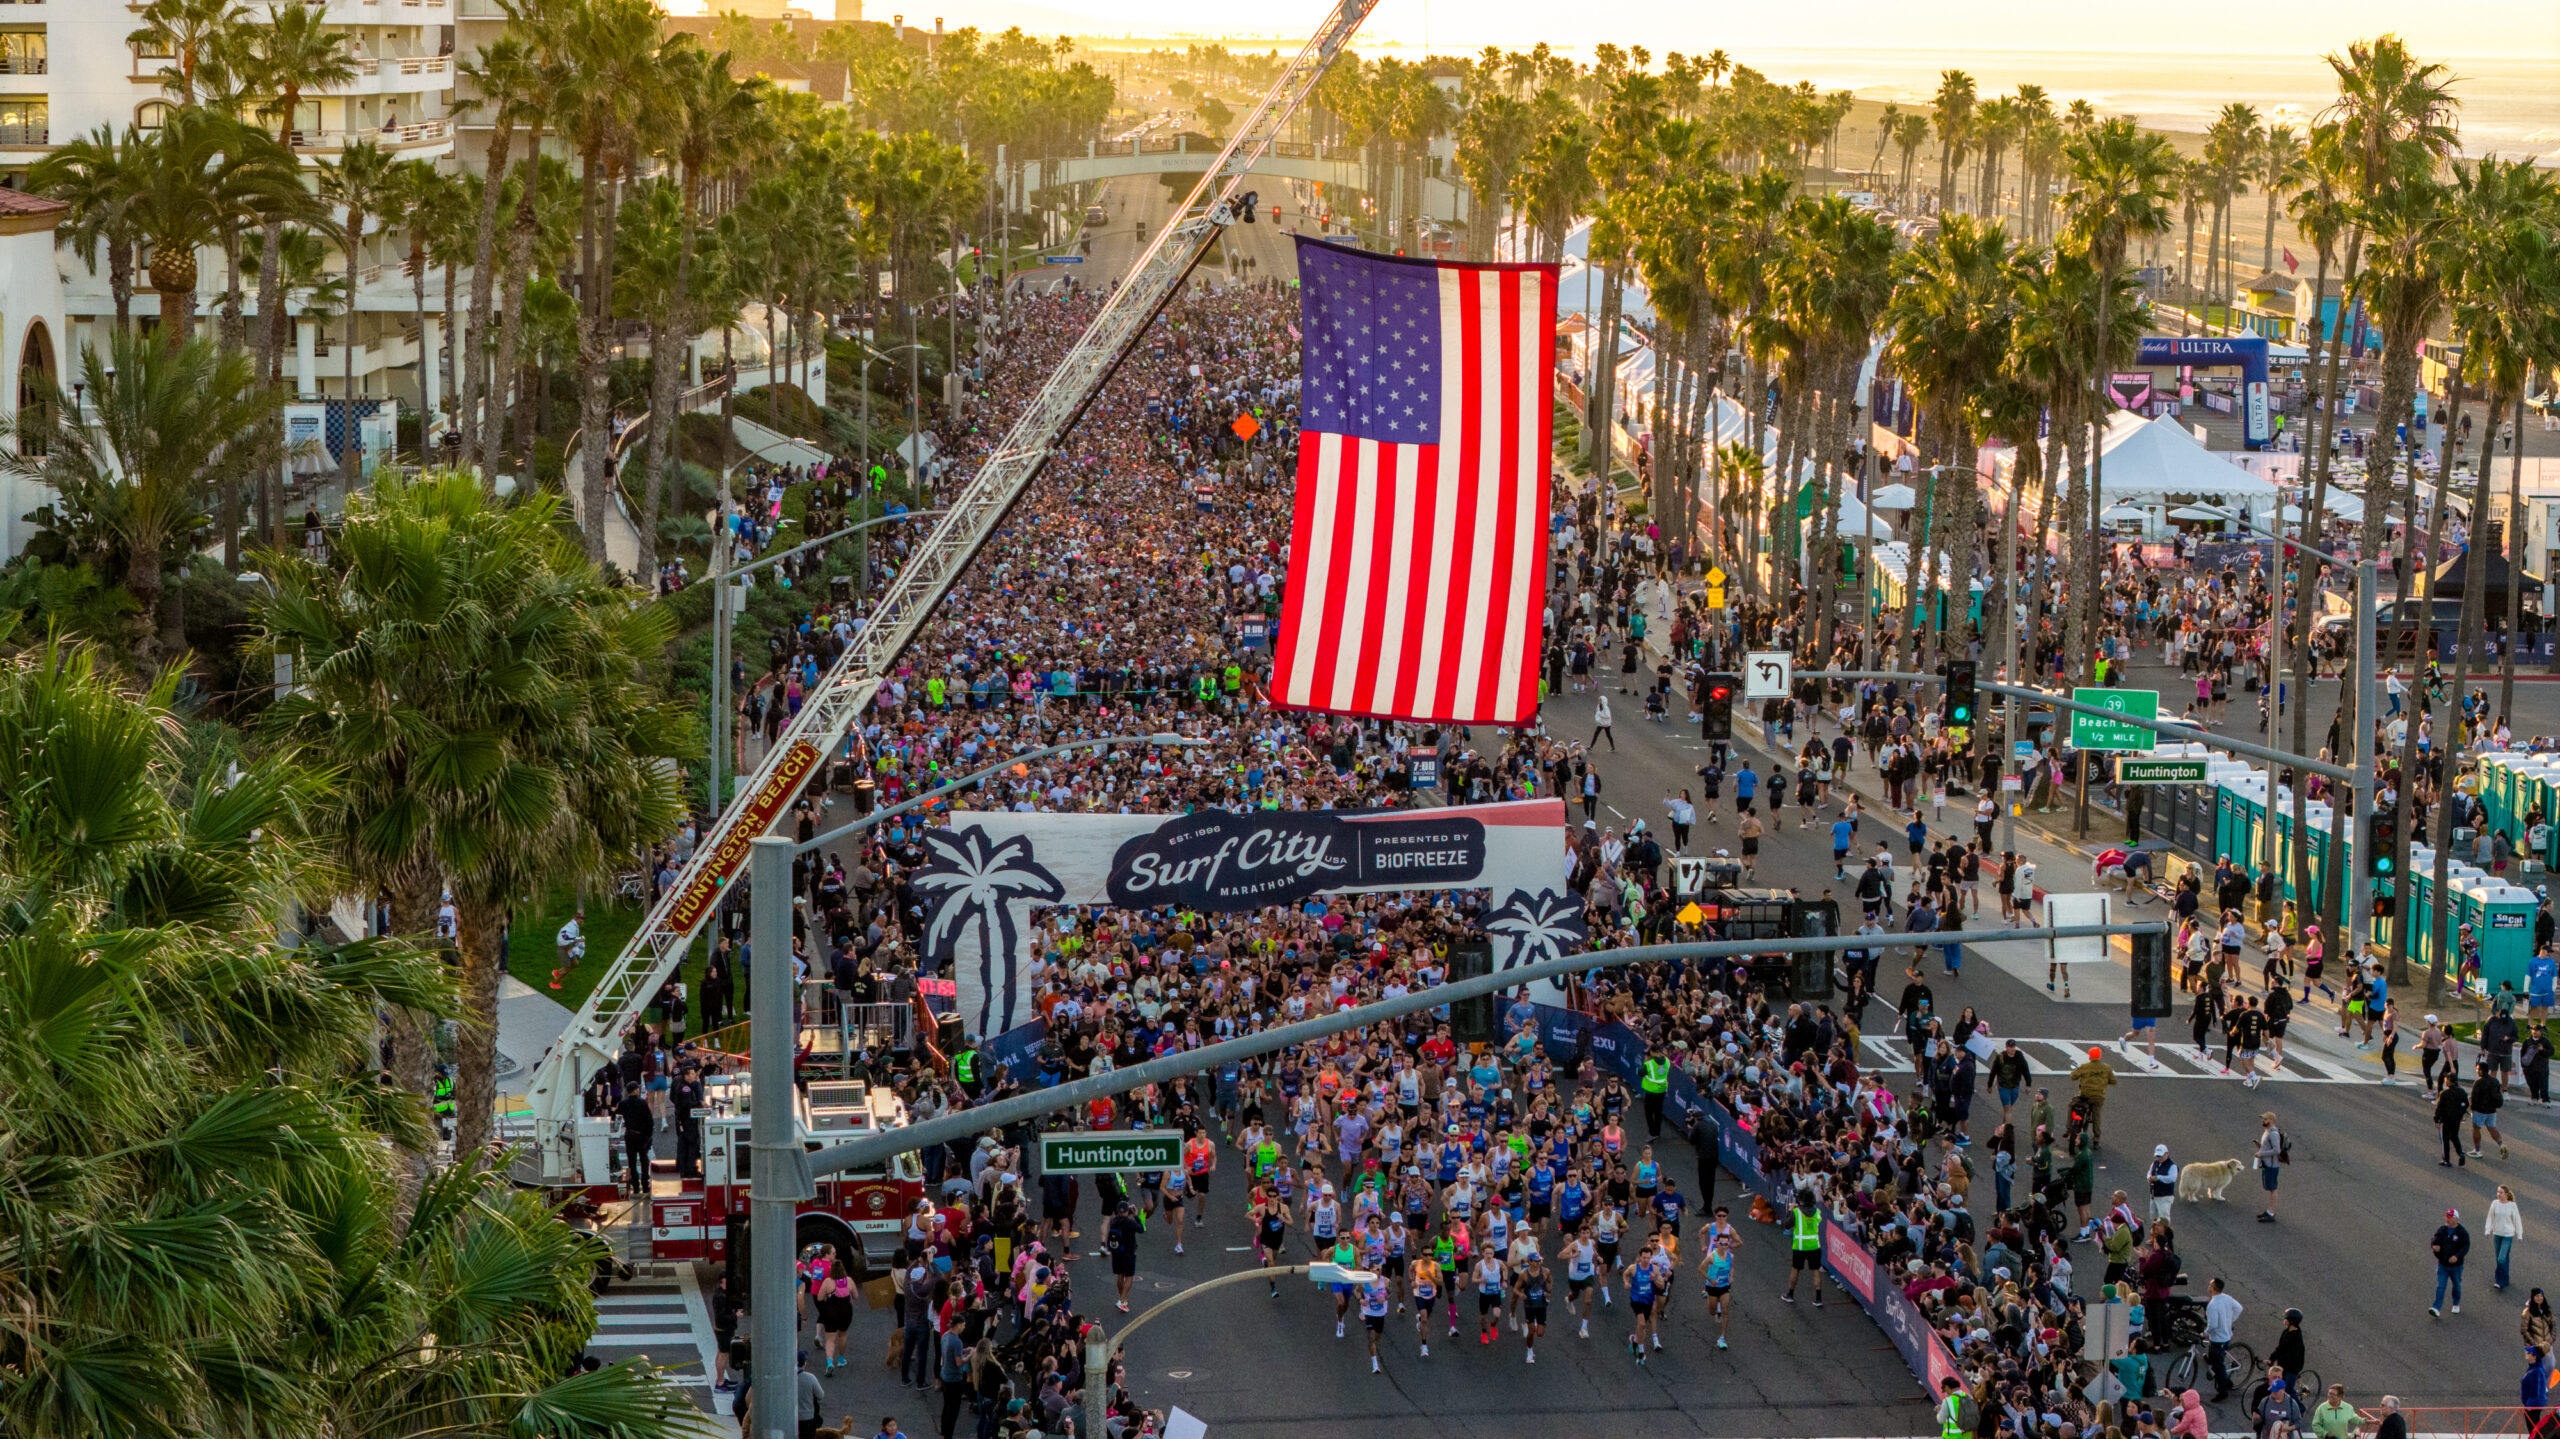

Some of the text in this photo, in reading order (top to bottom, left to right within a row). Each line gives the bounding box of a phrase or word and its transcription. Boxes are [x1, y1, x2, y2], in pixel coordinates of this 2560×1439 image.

[1162, 159, 1215, 167] HUNTINGTO
[2180, 342, 2233, 354] ULTRA
[2256, 397, 2264, 430] ULTRA
[2219, 551, 2243, 564] Surf
[2107, 701, 2122, 711] 39
[2079, 717, 2116, 727] Beach
[2113, 733, 2135, 742] MILE
[1413, 761, 1435, 770] 7:00
[2129, 765, 2198, 781] Huntington
[675, 749, 811, 925] HUNTINGTON BEACH
[730, 841, 750, 863] TRUCK
[757, 819, 766, 829] 45
[1168, 825, 1221, 846] EST. 1996
[1375, 834, 1470, 845] PRESENTED BY
[1125, 828, 1345, 892] Surf City
[1324, 855, 1348, 864] USA
[1220, 875, 1296, 897] MARATHON
[1592, 1035, 1616, 1051] 2XU
[1058, 1144, 1167, 1168] Huntington
[739, 1188, 752, 1197] HT
[854, 1184, 900, 1195] HUNTINGTON BEACH
